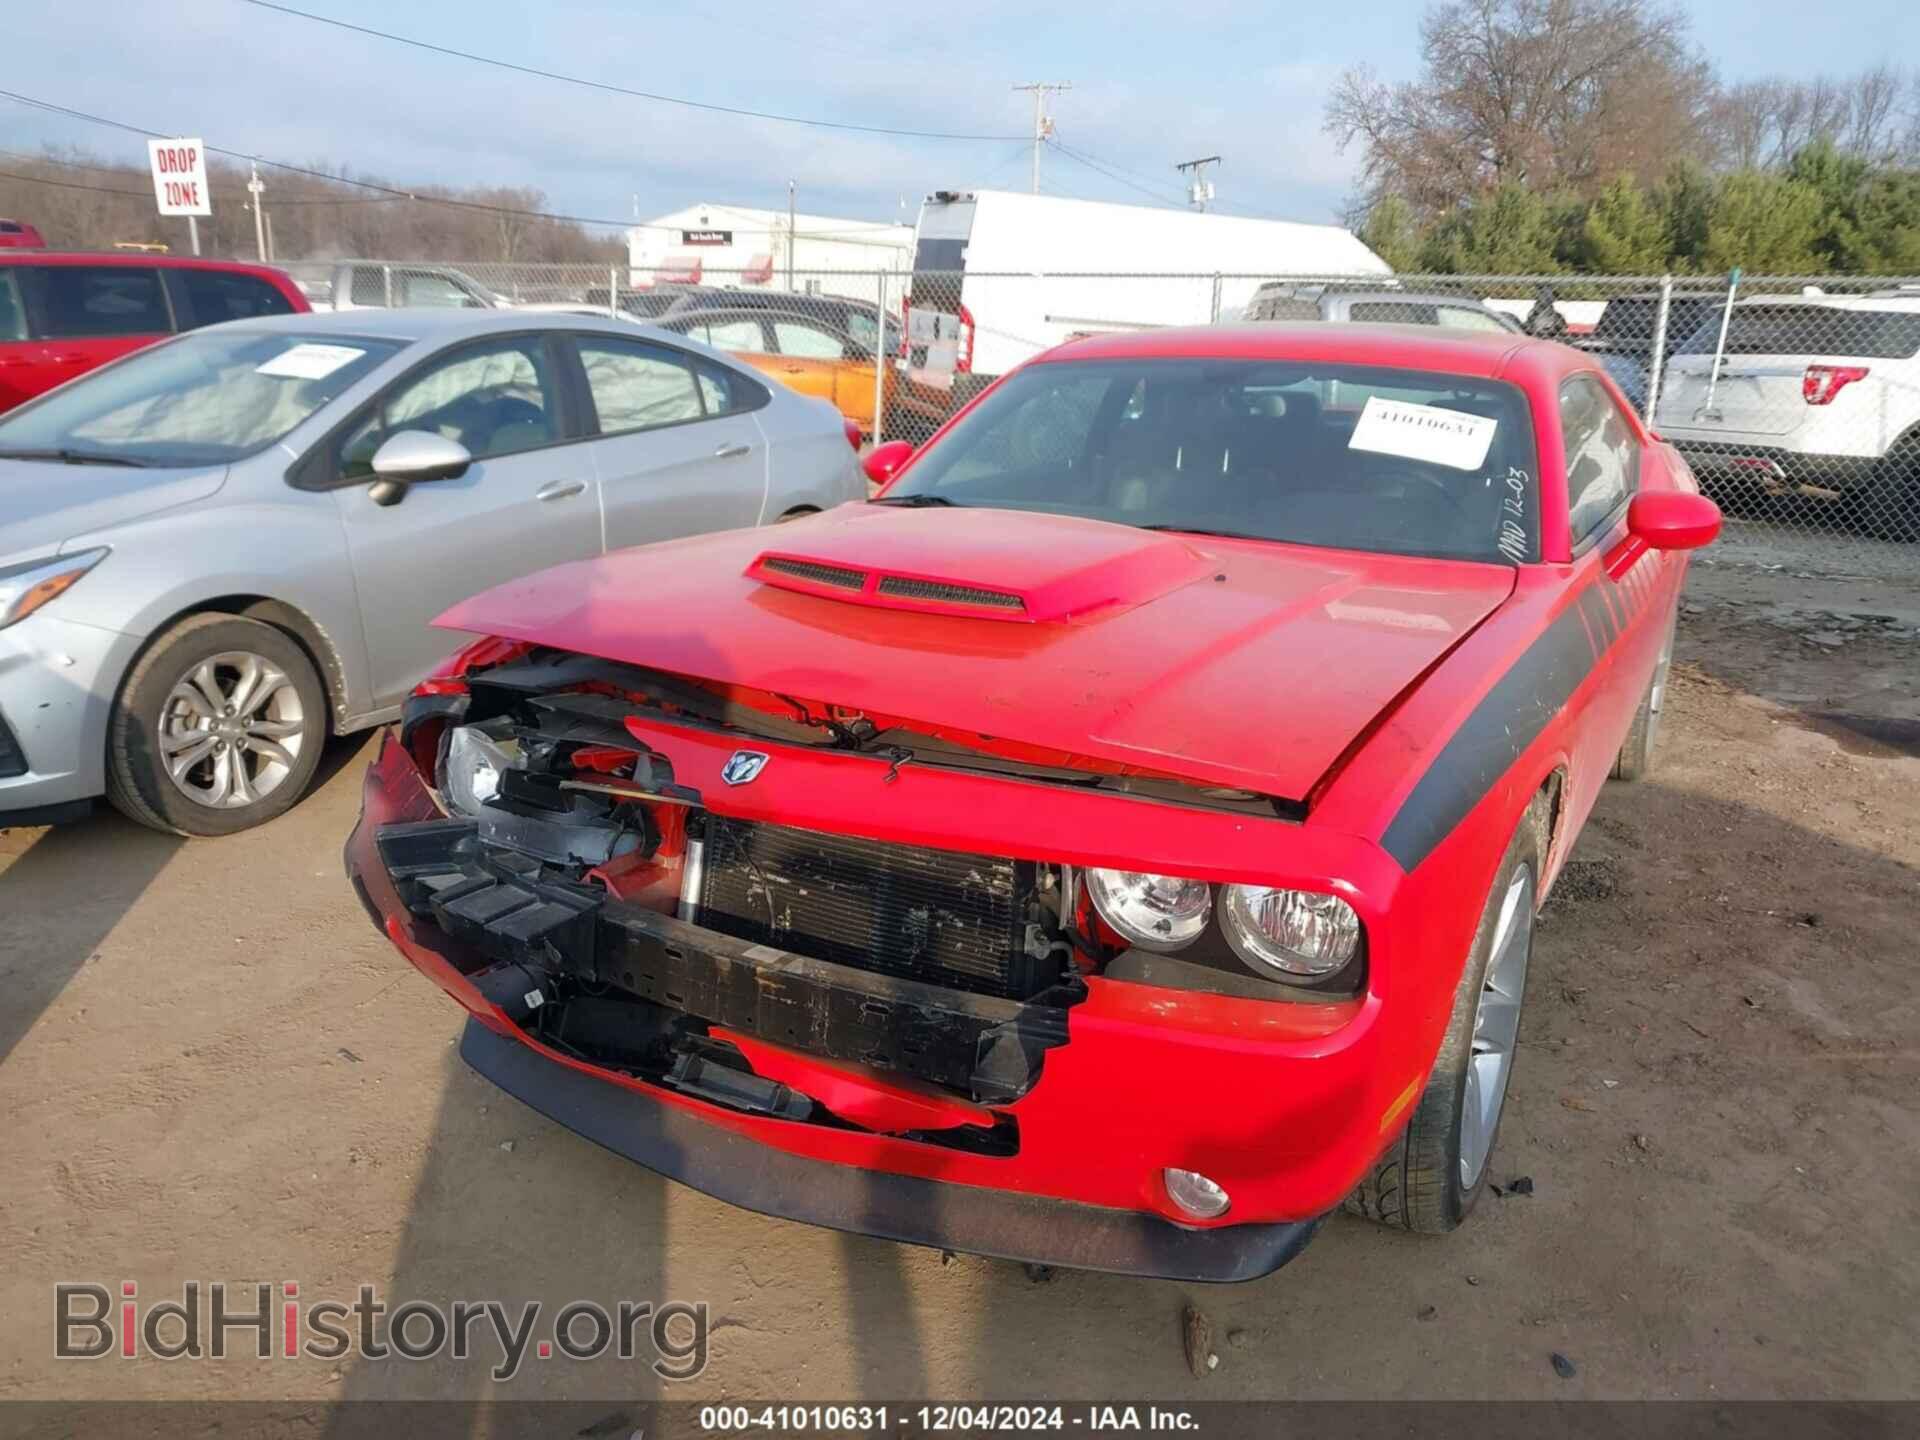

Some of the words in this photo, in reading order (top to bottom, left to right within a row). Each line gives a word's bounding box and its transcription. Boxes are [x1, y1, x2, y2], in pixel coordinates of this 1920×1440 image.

[157, 148, 196, 173] DROP
[165, 182, 199, 206] ZONE
[1376, 411, 1475, 436] 41010631
